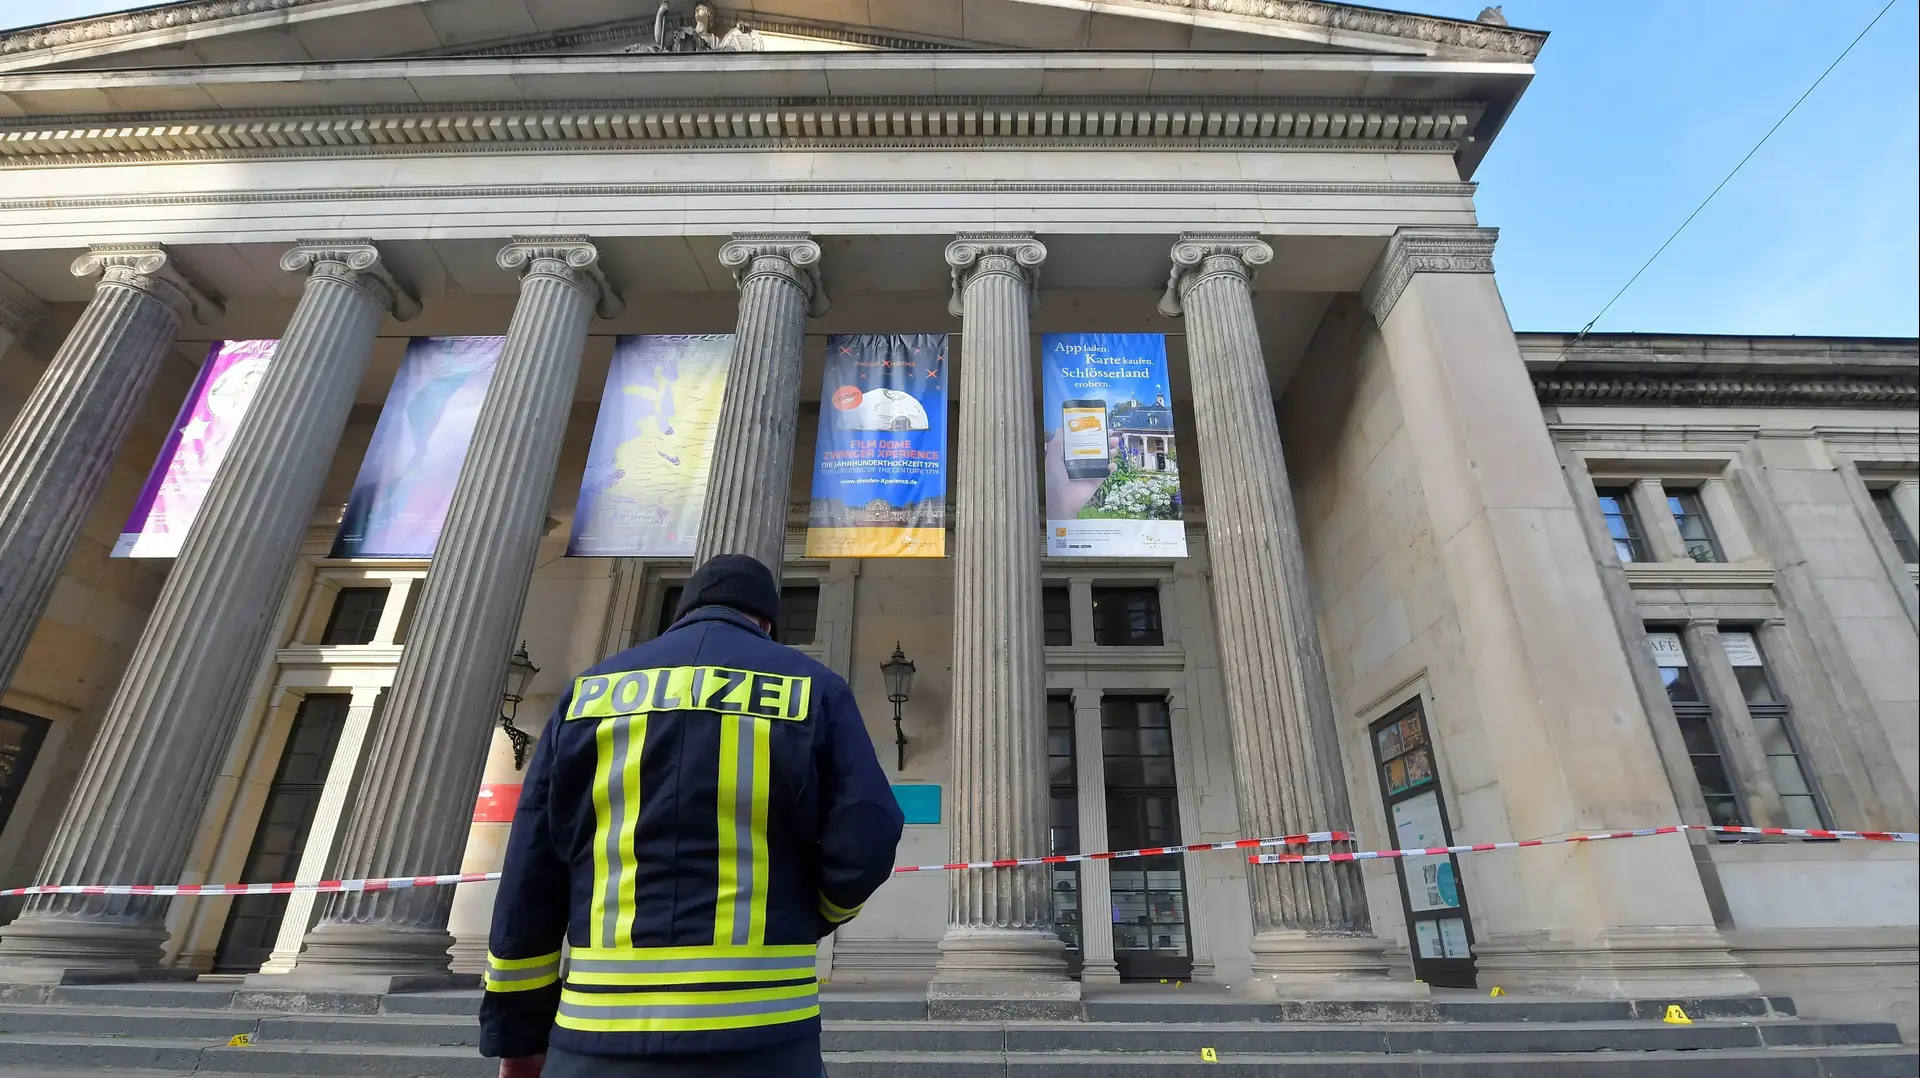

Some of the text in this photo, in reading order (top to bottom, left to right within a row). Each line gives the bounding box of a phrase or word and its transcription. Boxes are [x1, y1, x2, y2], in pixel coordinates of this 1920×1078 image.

[1054, 341, 1082, 355] App
[1085, 353, 1121, 365] Karte
[1061, 367, 1150, 379] Schlösserland
[850, 440, 911, 449] FILM DOME
[823, 450, 939, 460] ZWINGER XPERIENCE
[833, 459, 925, 469] JAHRHUNDERTHOCHZEIT
[924, 461, 939, 469] 1719
[840, 478, 918, 486] www.dresden-Xperience.de
[1650, 637, 1679, 651] AFÉ
[572, 667, 803, 718] POLIZEI
[238, 1035, 248, 1044] 15
[1206, 1049, 1213, 1058] 4
